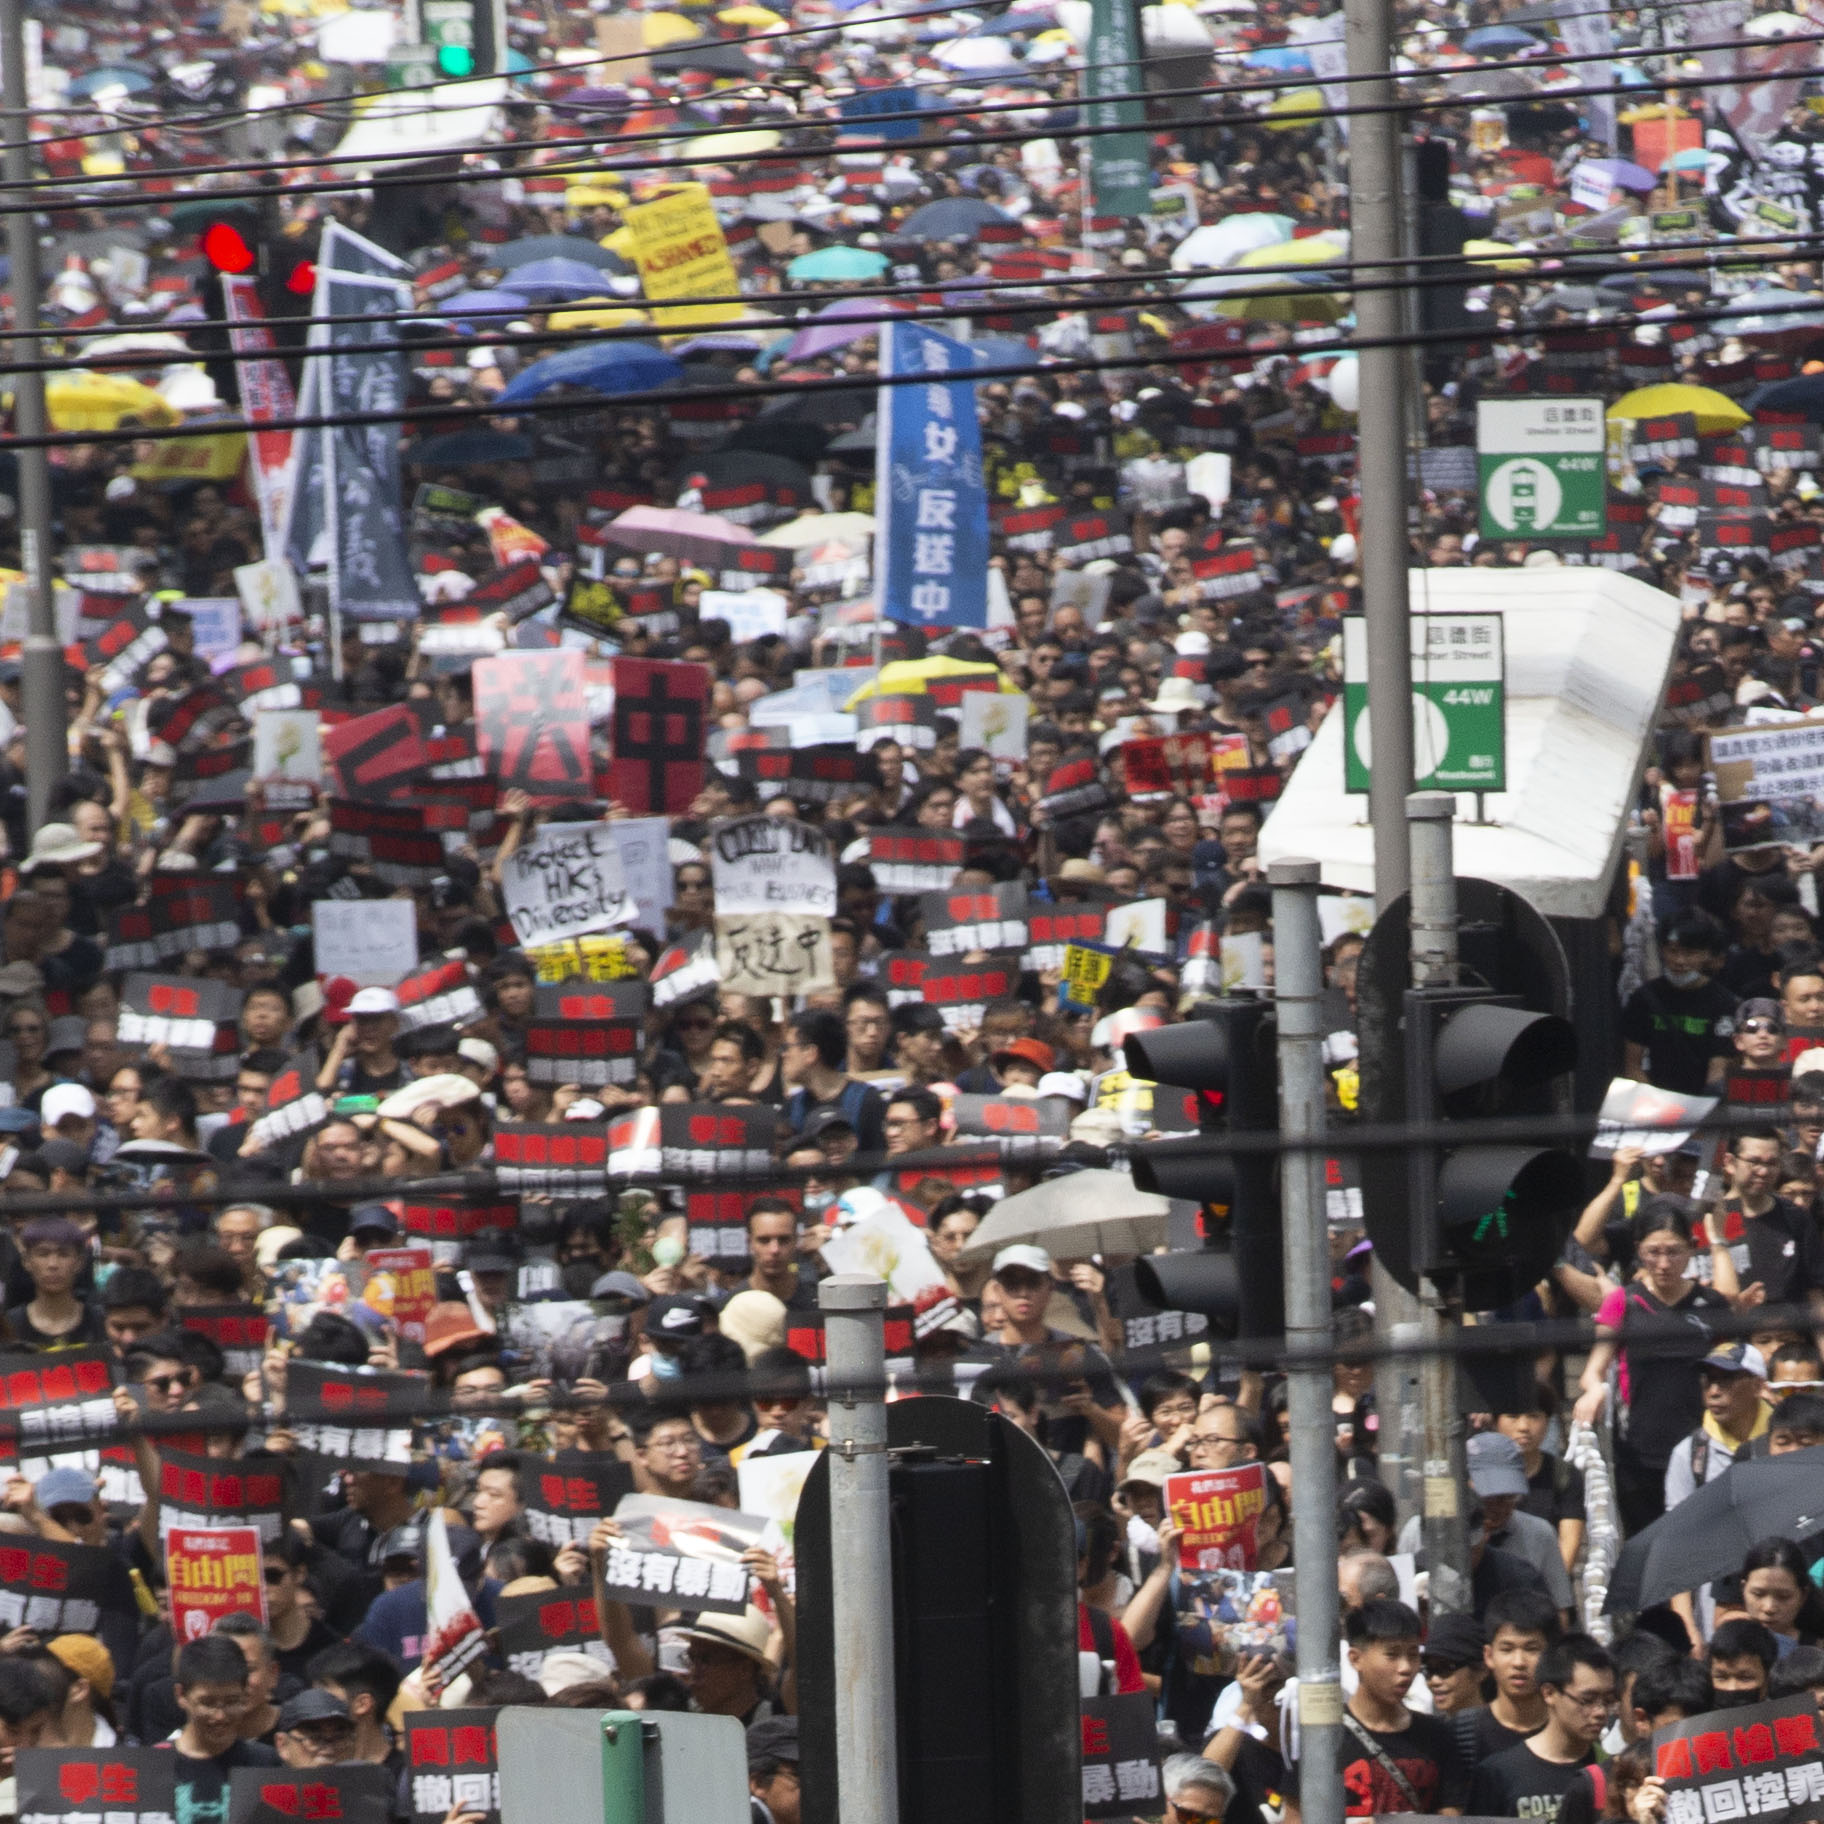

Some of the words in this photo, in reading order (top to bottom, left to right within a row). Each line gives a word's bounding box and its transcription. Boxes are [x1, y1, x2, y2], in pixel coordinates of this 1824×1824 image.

[1442, 689, 1493, 705] 44W
[614, 674, 703, 812] 中
[508, 886, 630, 941] Diversity
[60, 1763, 140, 1805] 學生
